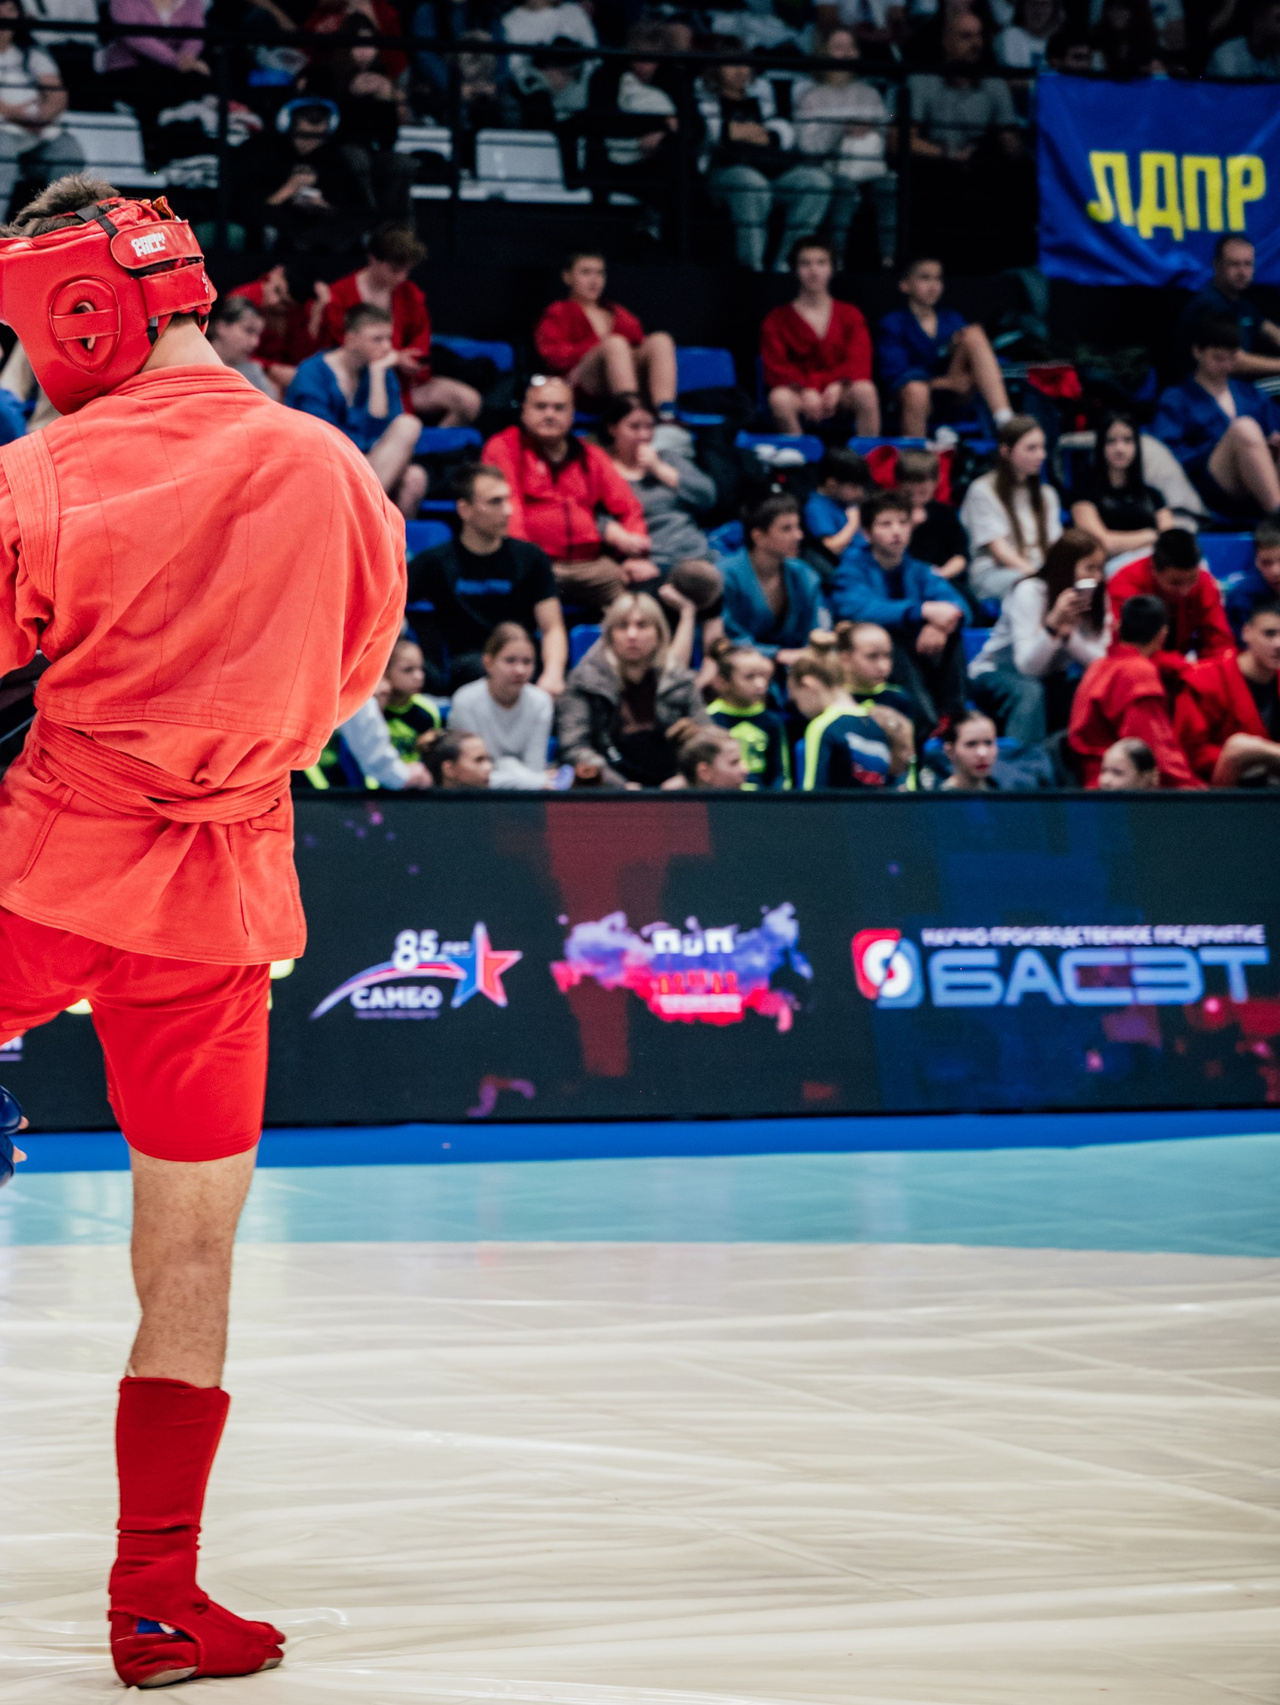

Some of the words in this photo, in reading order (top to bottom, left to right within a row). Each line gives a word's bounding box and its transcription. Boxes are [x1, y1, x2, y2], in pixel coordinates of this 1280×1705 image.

[1087, 151, 1266, 241] ЛДПР
[131, 232, 166, 248] GREEN
[134, 241, 166, 257] HILL
[391, 929, 439, 972] 85
[928, 946, 1269, 1006] БАСЭТ
[350, 985, 443, 1009] САМБО
